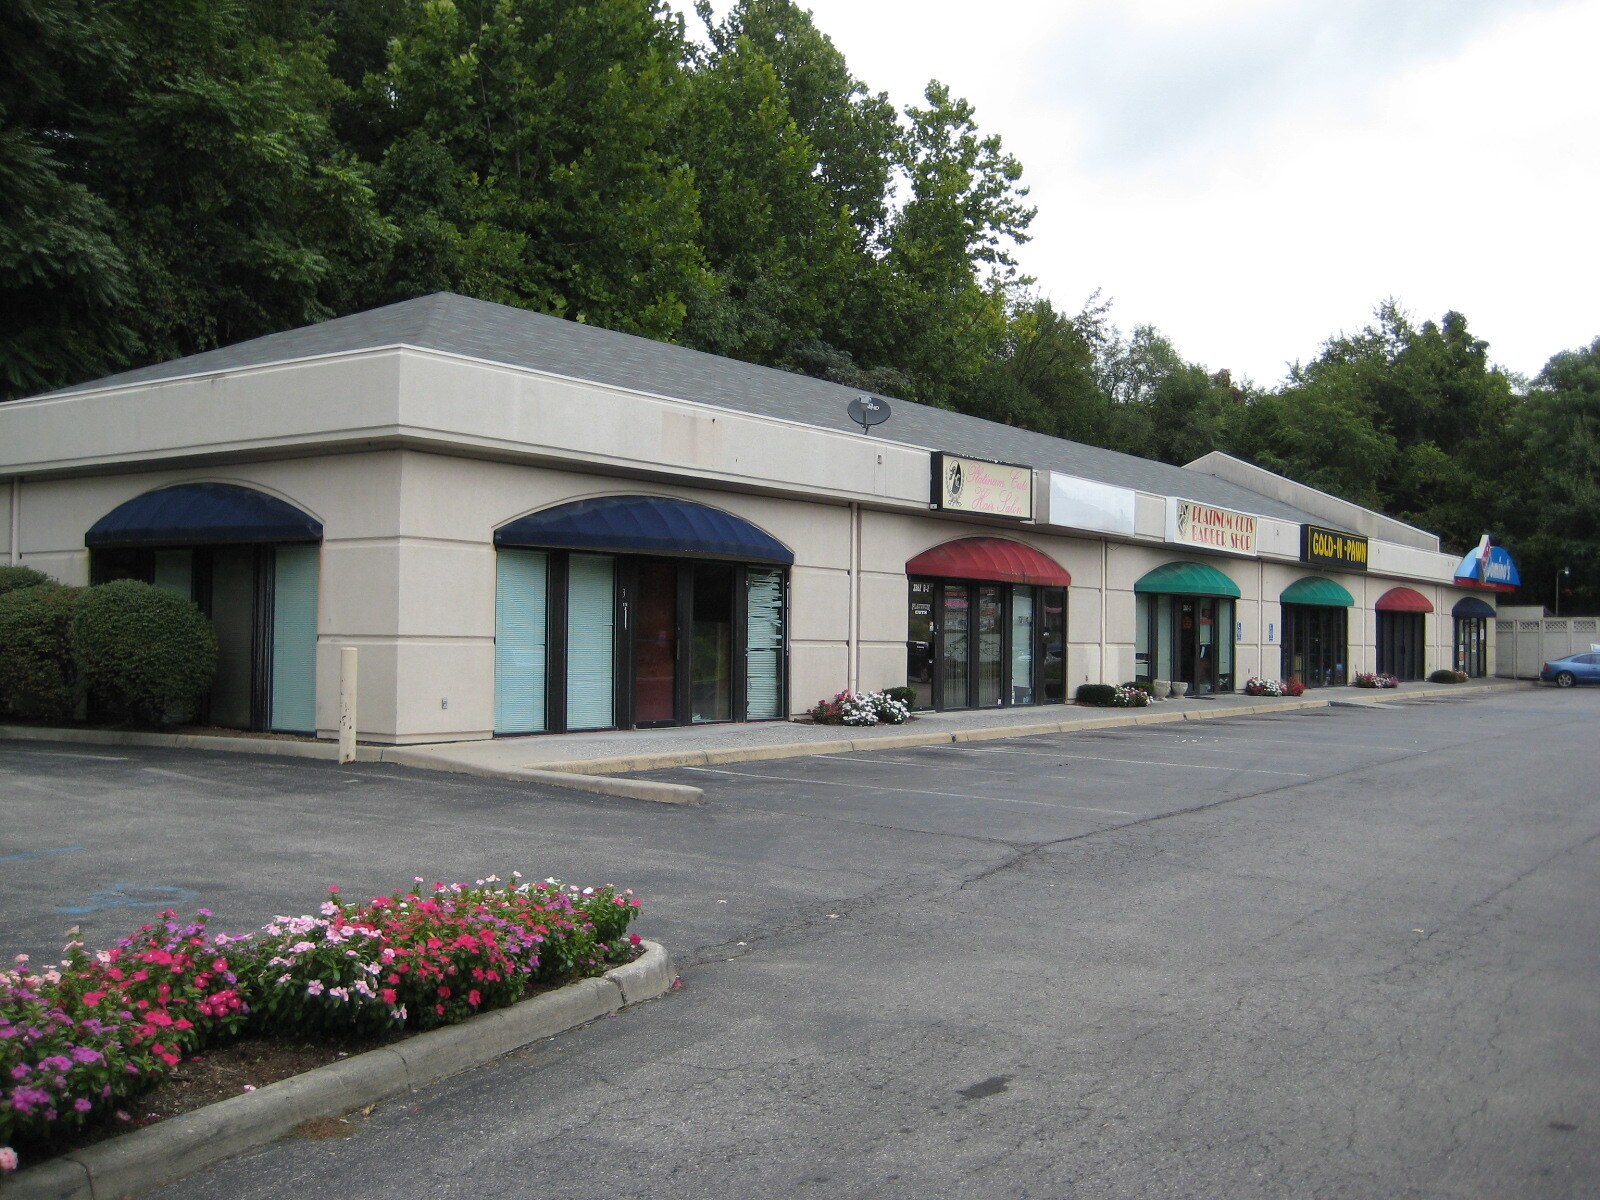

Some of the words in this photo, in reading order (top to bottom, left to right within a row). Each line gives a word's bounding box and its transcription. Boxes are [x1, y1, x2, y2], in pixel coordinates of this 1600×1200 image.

[966, 462, 1005, 487] Platinum
[971, 486, 995, 511] Hair
[996, 490, 1023, 515] Salon
[1192, 506, 1233, 529] PLATINUM
[1235, 515, 1253, 533] CUTS
[1191, 525, 1227, 547] BARBER
[1230, 533, 1252, 551] SHOP
